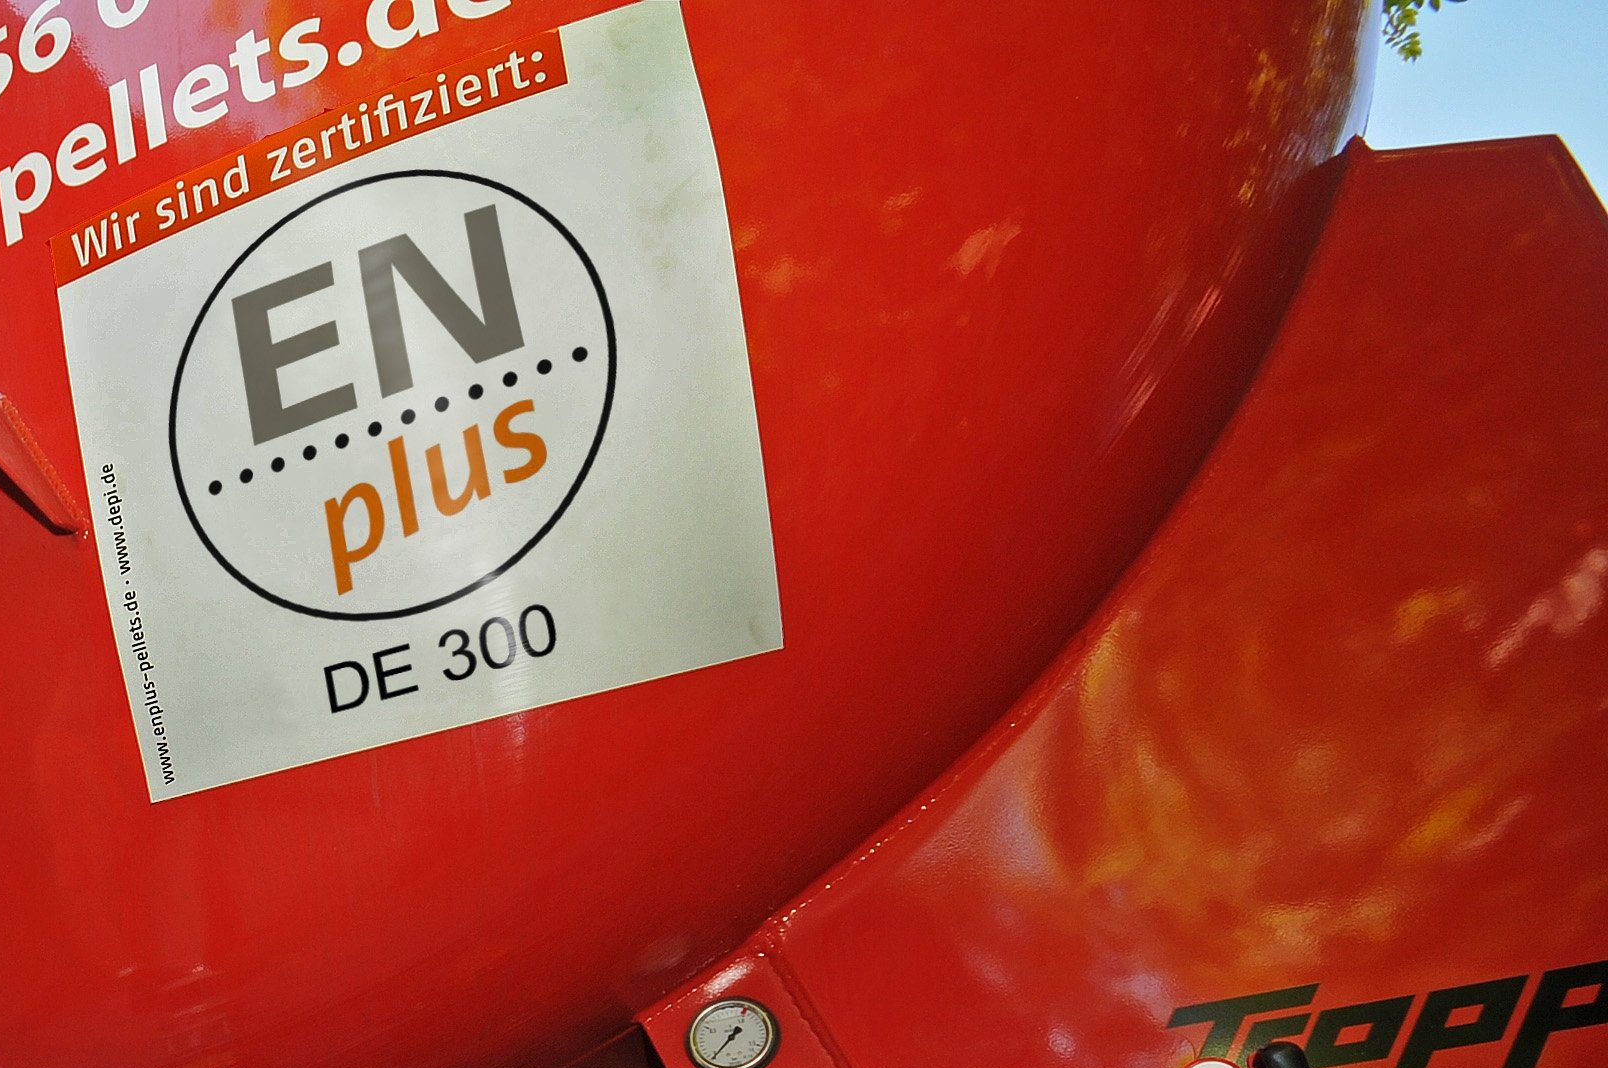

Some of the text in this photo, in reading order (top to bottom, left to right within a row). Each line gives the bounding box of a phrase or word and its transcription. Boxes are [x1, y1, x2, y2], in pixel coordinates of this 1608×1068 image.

[70, 49, 548, 270] Wir sind zertifiziert:
[230, 203, 526, 446] EN
[323, 397, 548, 598] plus
[100, 462, 175, 786] www.enplus-pellets.de www.depi.de
[323, 603, 558, 713] DE 300
